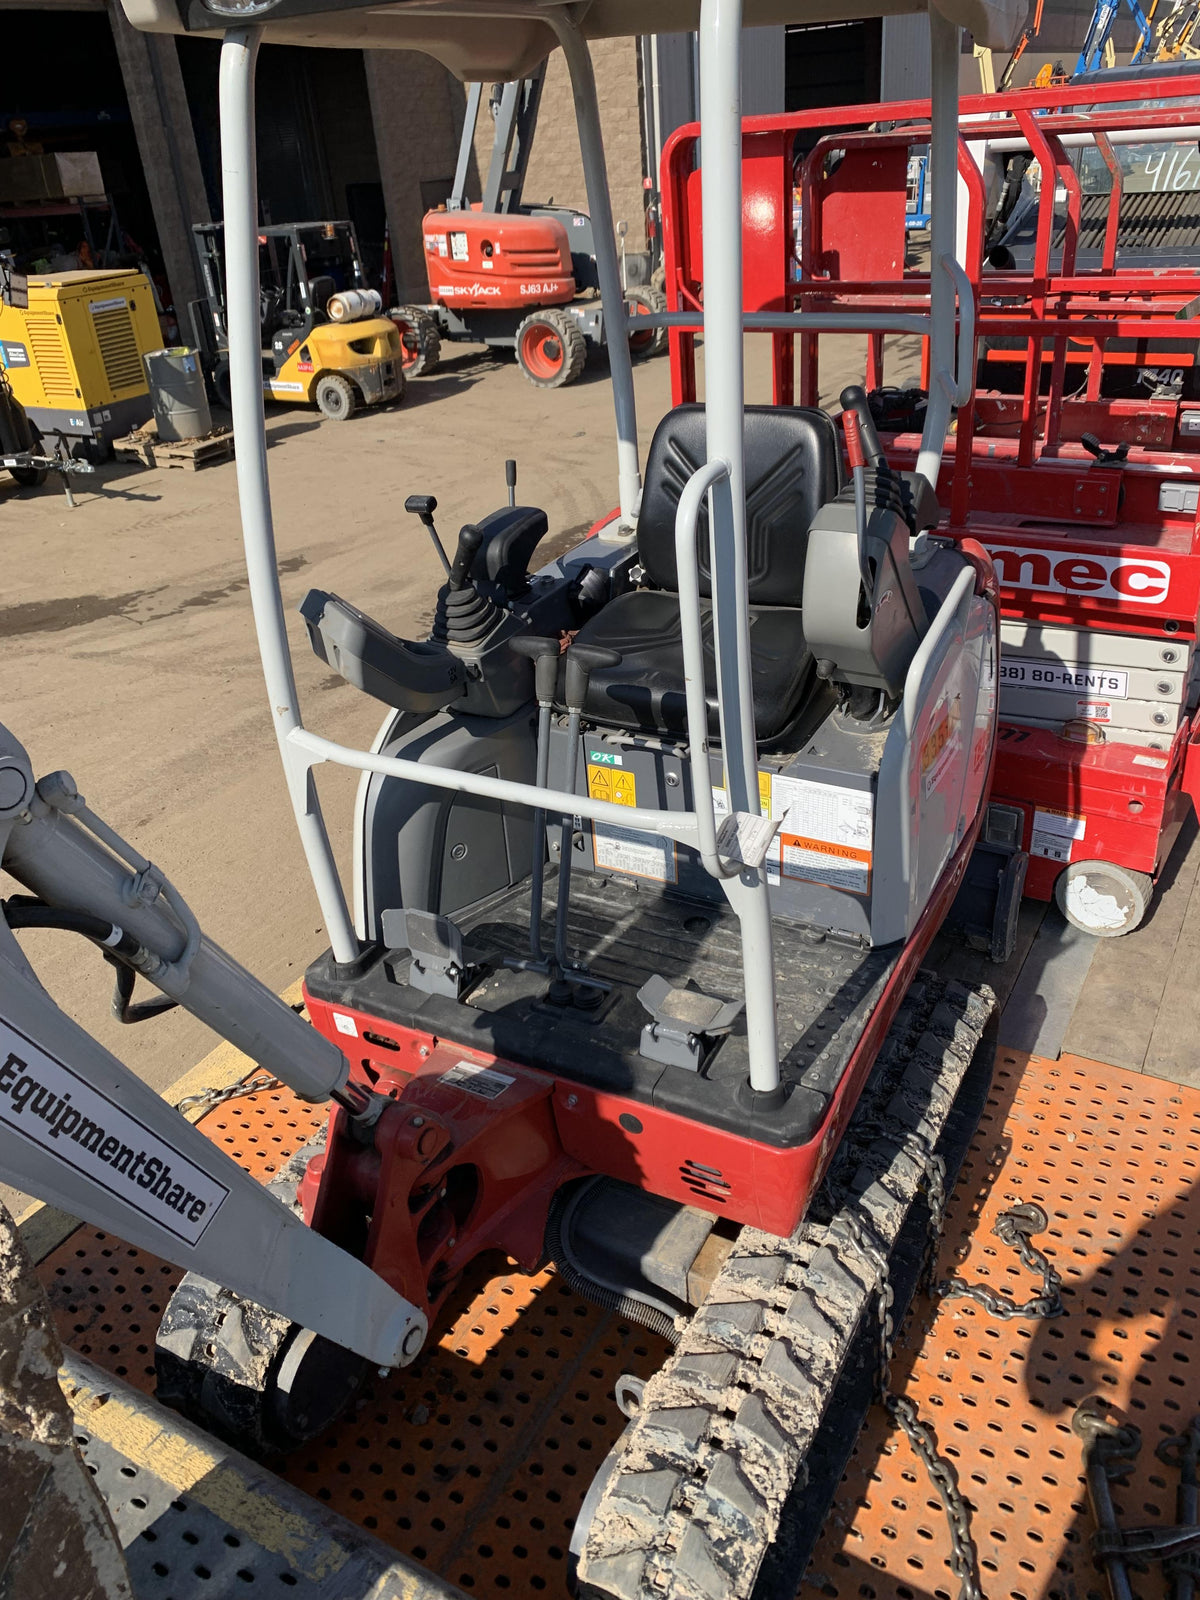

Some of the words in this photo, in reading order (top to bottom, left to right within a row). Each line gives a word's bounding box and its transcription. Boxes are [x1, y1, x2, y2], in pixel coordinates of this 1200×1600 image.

[454, 283, 501, 296] SKYJACK
[520, 284, 541, 295] SJ63
[991, 550, 1167, 598] mec
[1031, 669, 1119, 691] 80-RENTS
[591, 751, 614, 763] OK
[803, 841, 858, 859] WARNING
[0, 1052, 207, 1224] EquipmentShare
